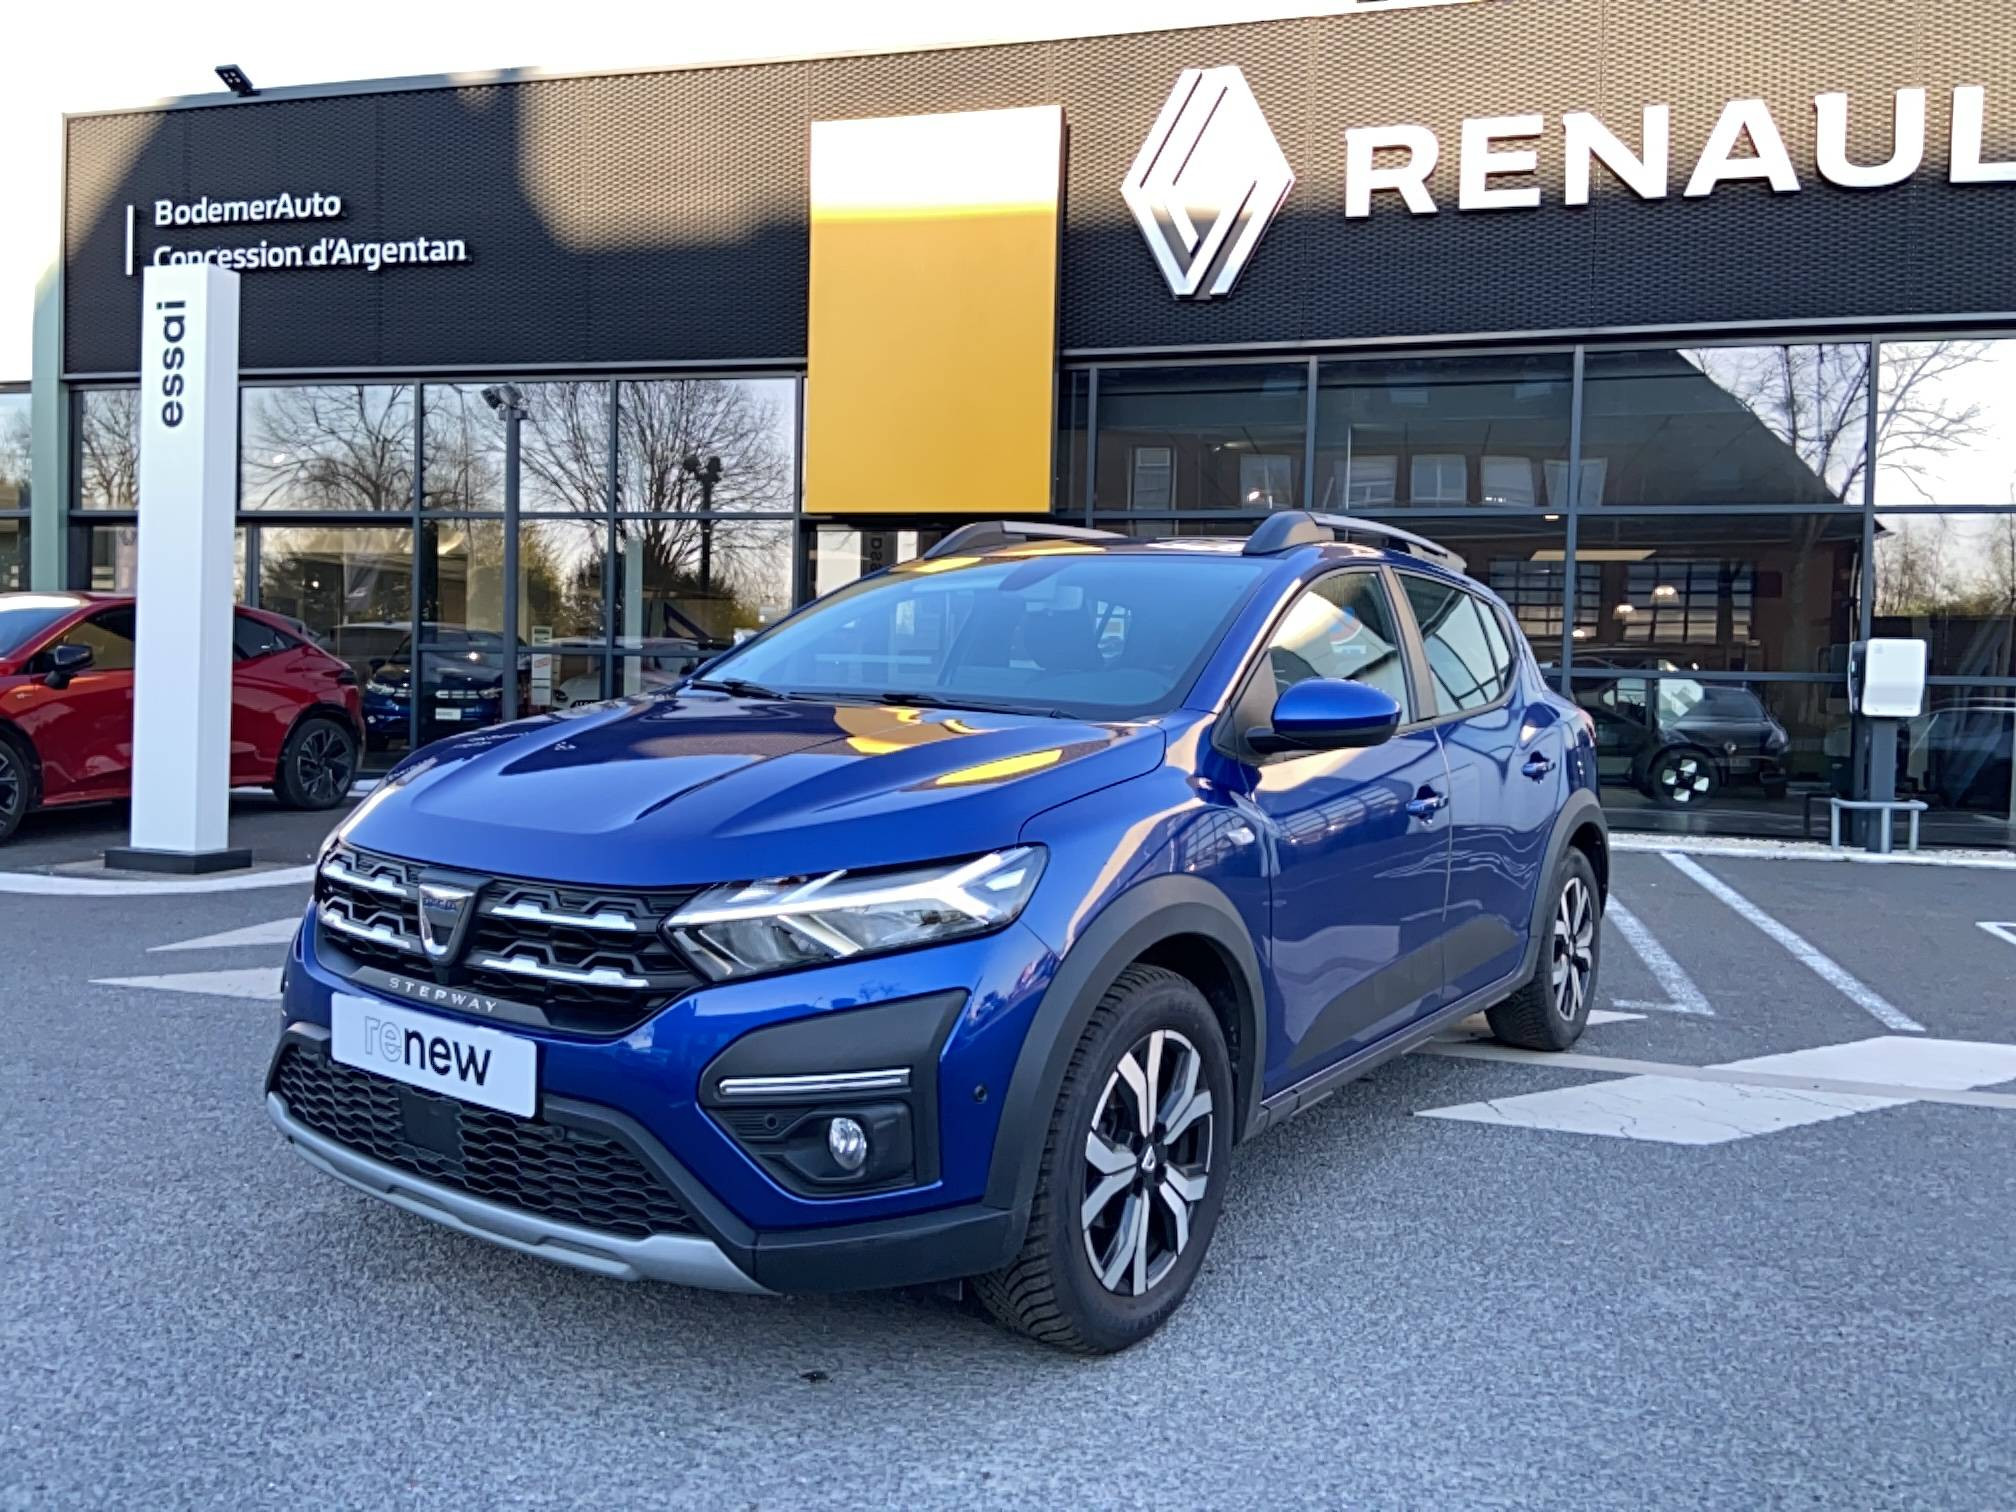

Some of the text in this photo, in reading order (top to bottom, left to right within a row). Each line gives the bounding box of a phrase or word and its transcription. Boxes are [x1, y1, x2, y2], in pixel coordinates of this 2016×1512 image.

[154, 192, 341, 225] BodemerAuto
[309, 236, 467, 271] d'Argentan
[156, 300, 186, 428] essai
[388, 977, 497, 1013] STEPWAY
[364, 1015, 492, 1087] renew
